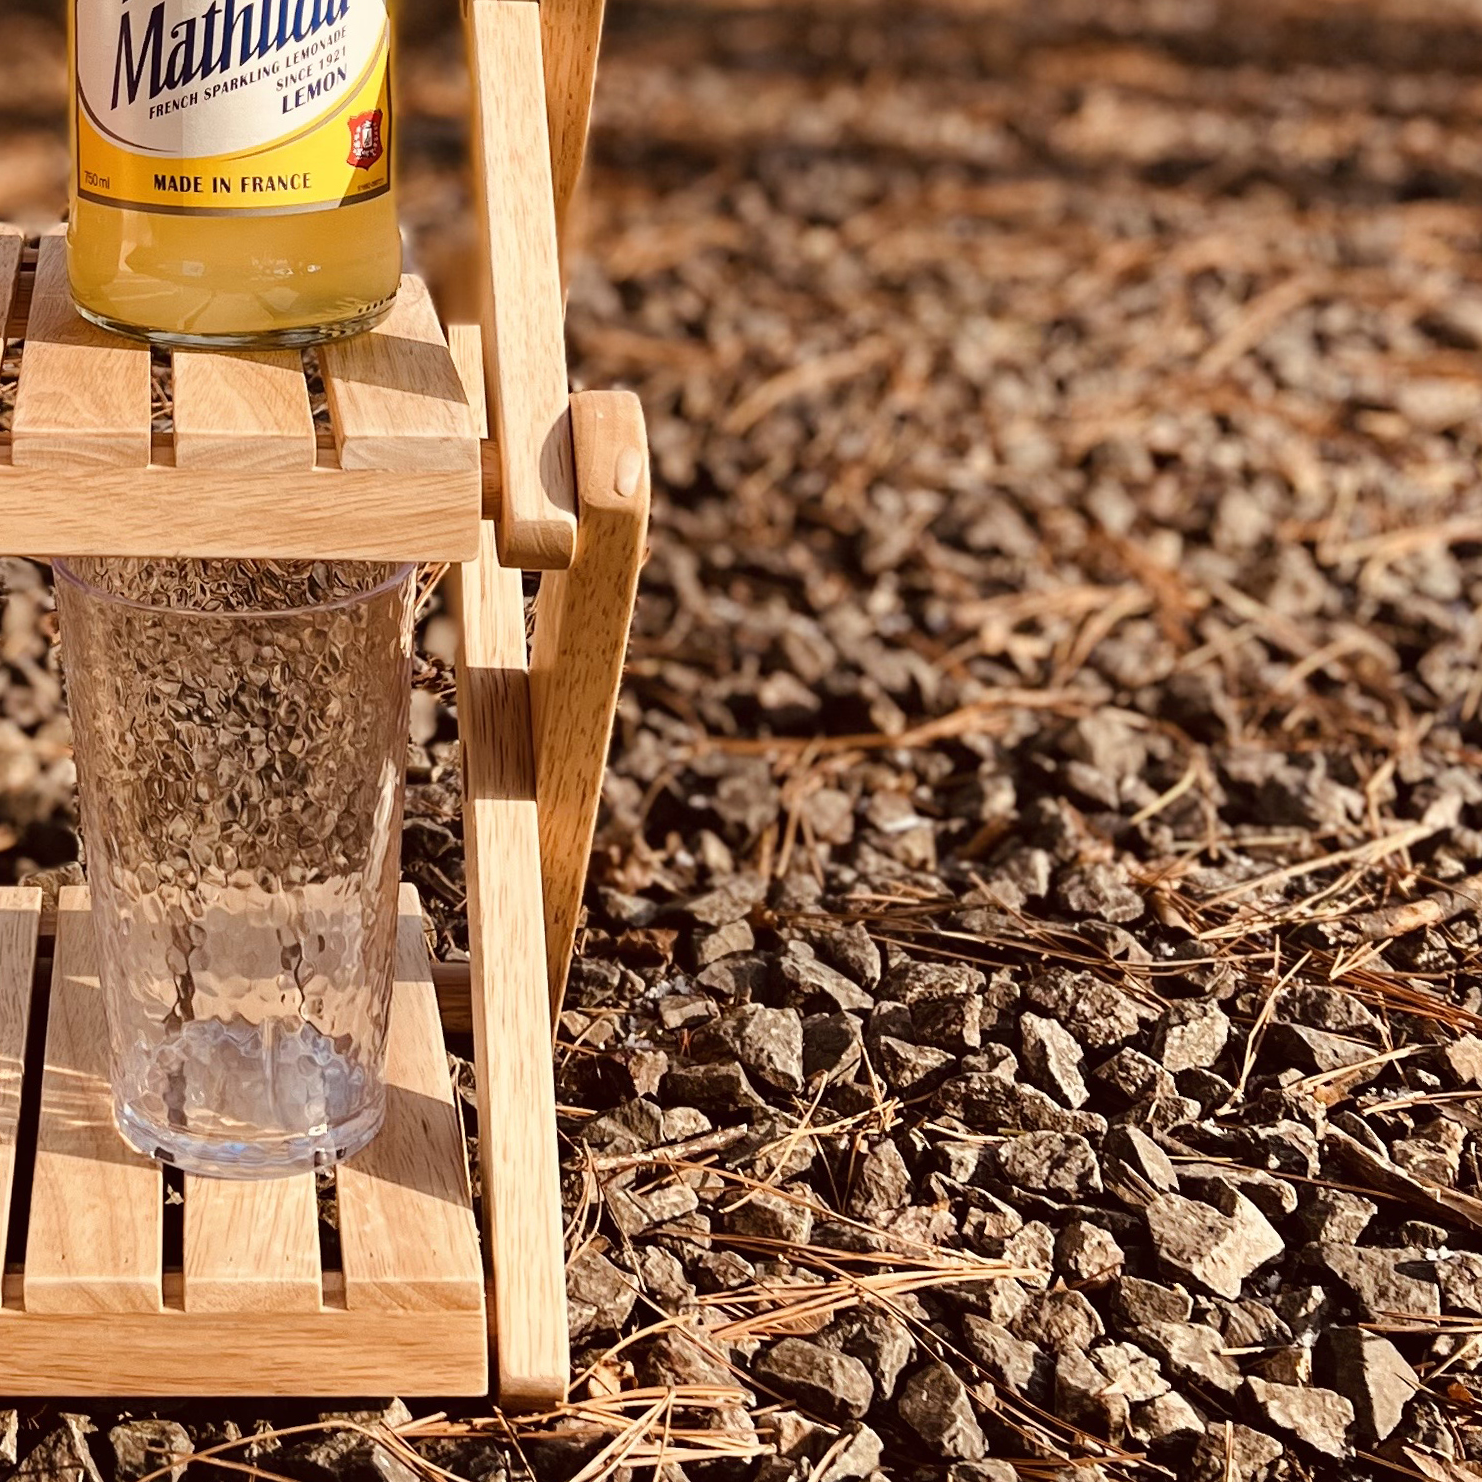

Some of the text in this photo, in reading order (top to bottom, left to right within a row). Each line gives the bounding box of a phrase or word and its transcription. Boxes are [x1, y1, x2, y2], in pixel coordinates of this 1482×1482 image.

[149, 25, 348, 120] FRENCH SPARKLING LEMONADE
[276, 45, 348, 92] SINCE 1921
[281, 63, 348, 115] LEMON
[84, 170, 110, 190] 750 ml
[153, 173, 312, 193] MADE IN FRANCE
